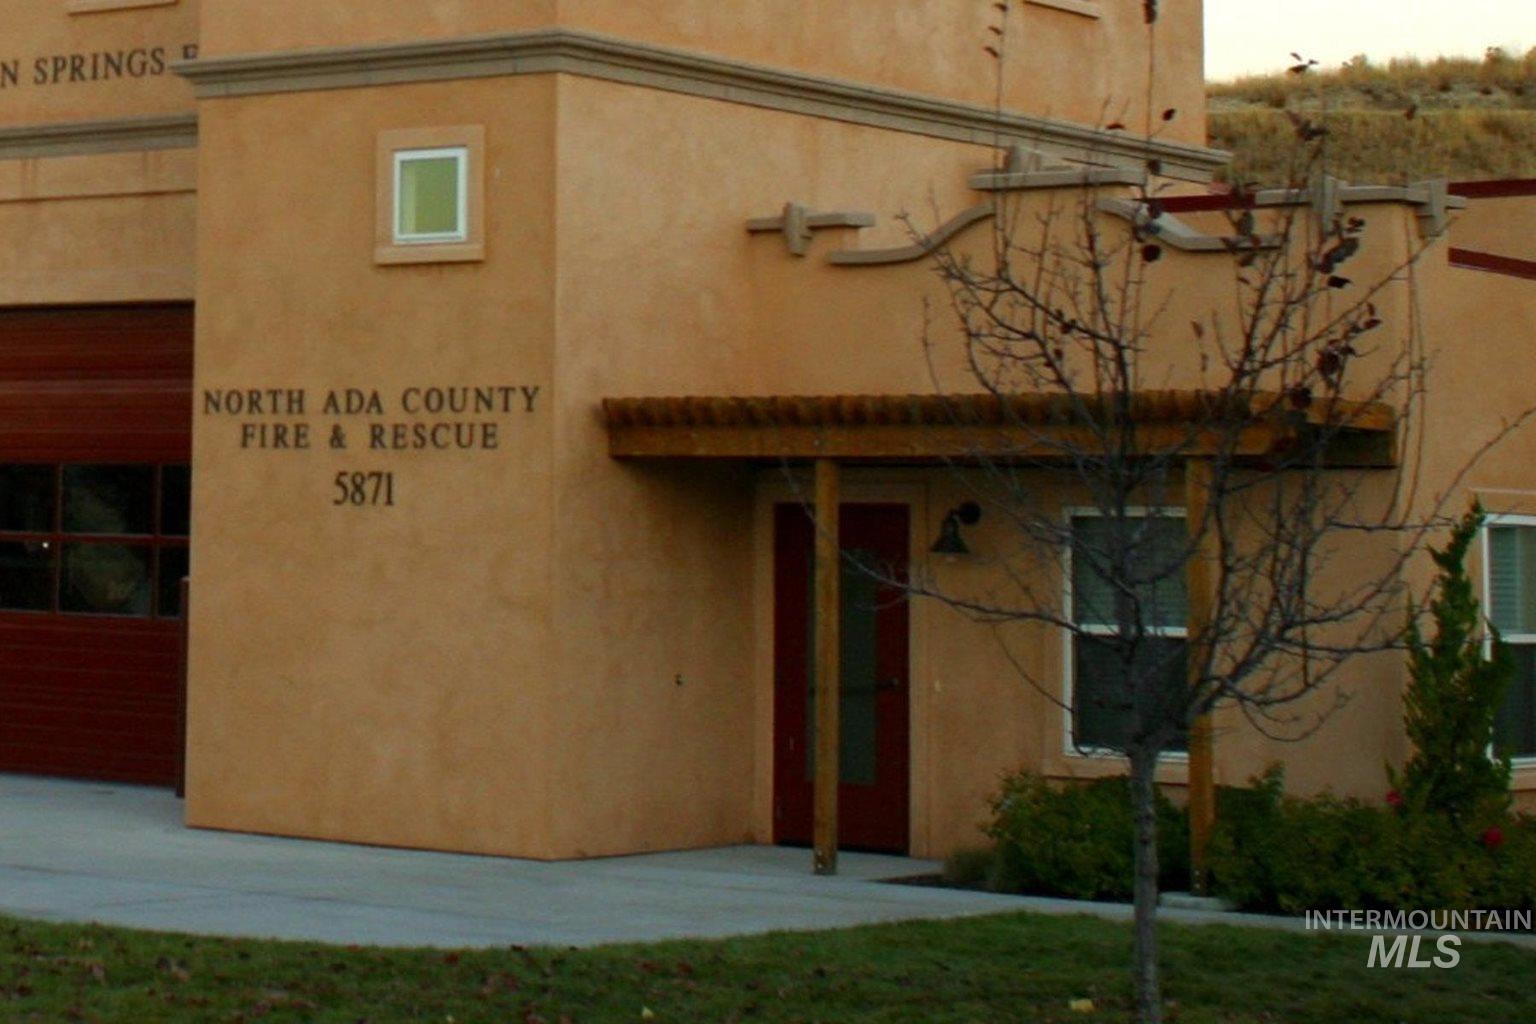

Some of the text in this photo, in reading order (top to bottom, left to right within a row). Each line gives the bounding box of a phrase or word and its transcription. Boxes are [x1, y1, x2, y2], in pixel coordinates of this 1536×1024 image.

[34, 47, 165, 85] SPRINGS
[204, 385, 540, 416] NORTH ADA COUNTY
[240, 422, 499, 450] FIRE & RESCUE
[332, 470, 395, 507] 5871
